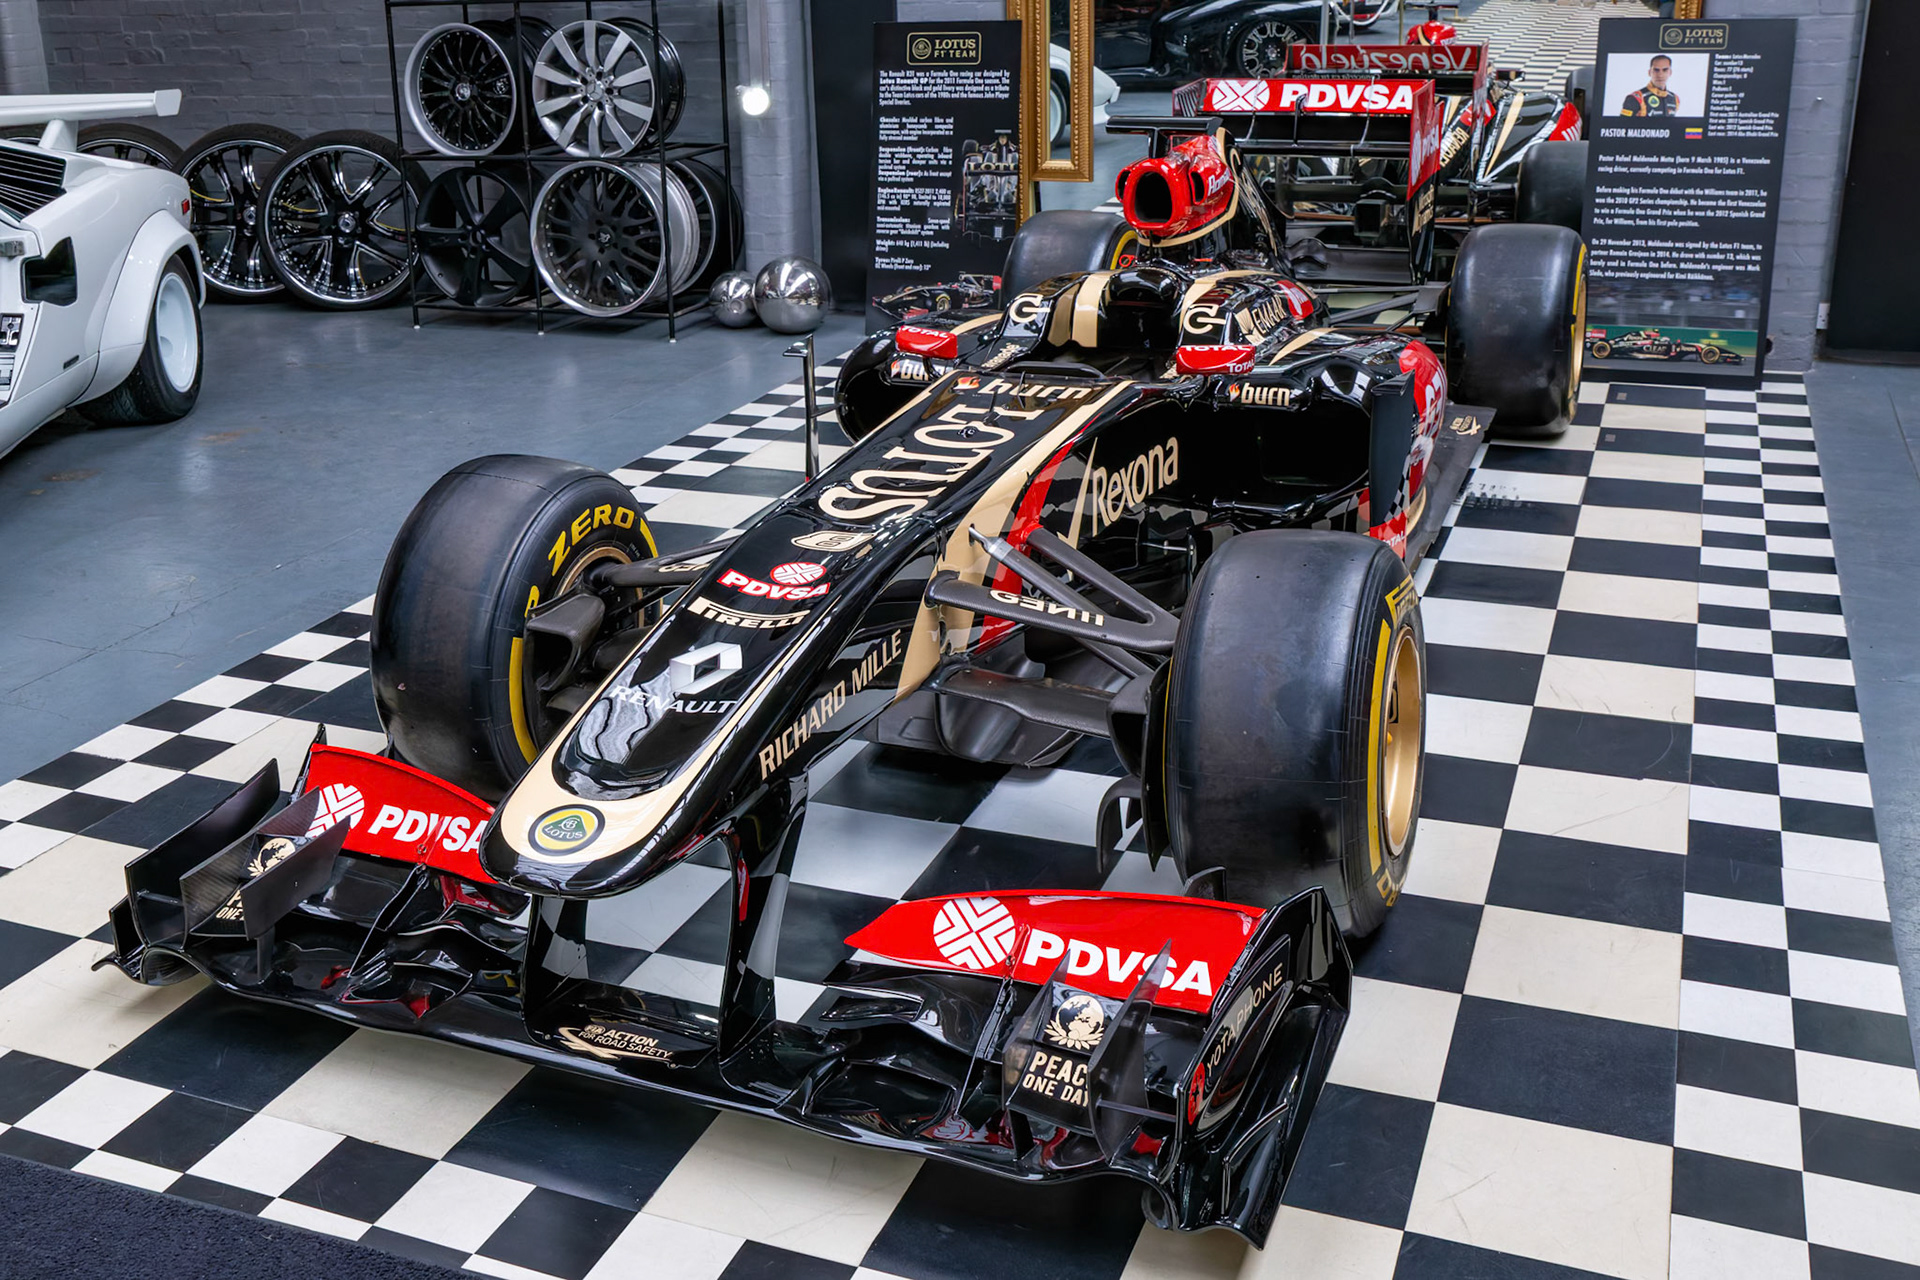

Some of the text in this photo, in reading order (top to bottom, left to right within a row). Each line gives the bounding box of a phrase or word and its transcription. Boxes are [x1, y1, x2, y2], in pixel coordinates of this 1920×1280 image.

[934, 39, 976, 49] LOTUS
[1686, 29, 1723, 38] LOTUS
[949, 50, 976, 58] TEAM
[1279, 83, 1413, 109] PDVSA
[1600, 128, 1670, 139] PASTOR MALDONADO
[1252, 295, 1286, 333] EMAAR
[902, 325, 949, 339] TOTAL
[1226, 358, 1255, 374] TOTAL
[978, 379, 1093, 400] burn
[1240, 382, 1290, 407] burn
[818, 404, 1045, 521] LOTUS
[1089, 436, 1179, 537] Rexona
[548, 503, 636, 577] ZERO
[718, 568, 831, 601] PDVSA
[687, 596, 811, 630] PIRELLI
[608, 685, 738, 715] RENAULT
[759, 628, 902, 781] RICHARD MILLE
[368, 804, 491, 855] PDVSA
[543, 825, 585, 842] LOTUS
[1023, 930, 1213, 997] PDVSA
[1204, 962, 1284, 1078] YOTAPHONE
[578, 1031, 674, 1060] FOR ROAD SAFETY
[604, 1029, 659, 1047] ACTION
[1022, 1074, 1058, 1097] ONE
[1028, 1051, 1090, 1091] PEAC
